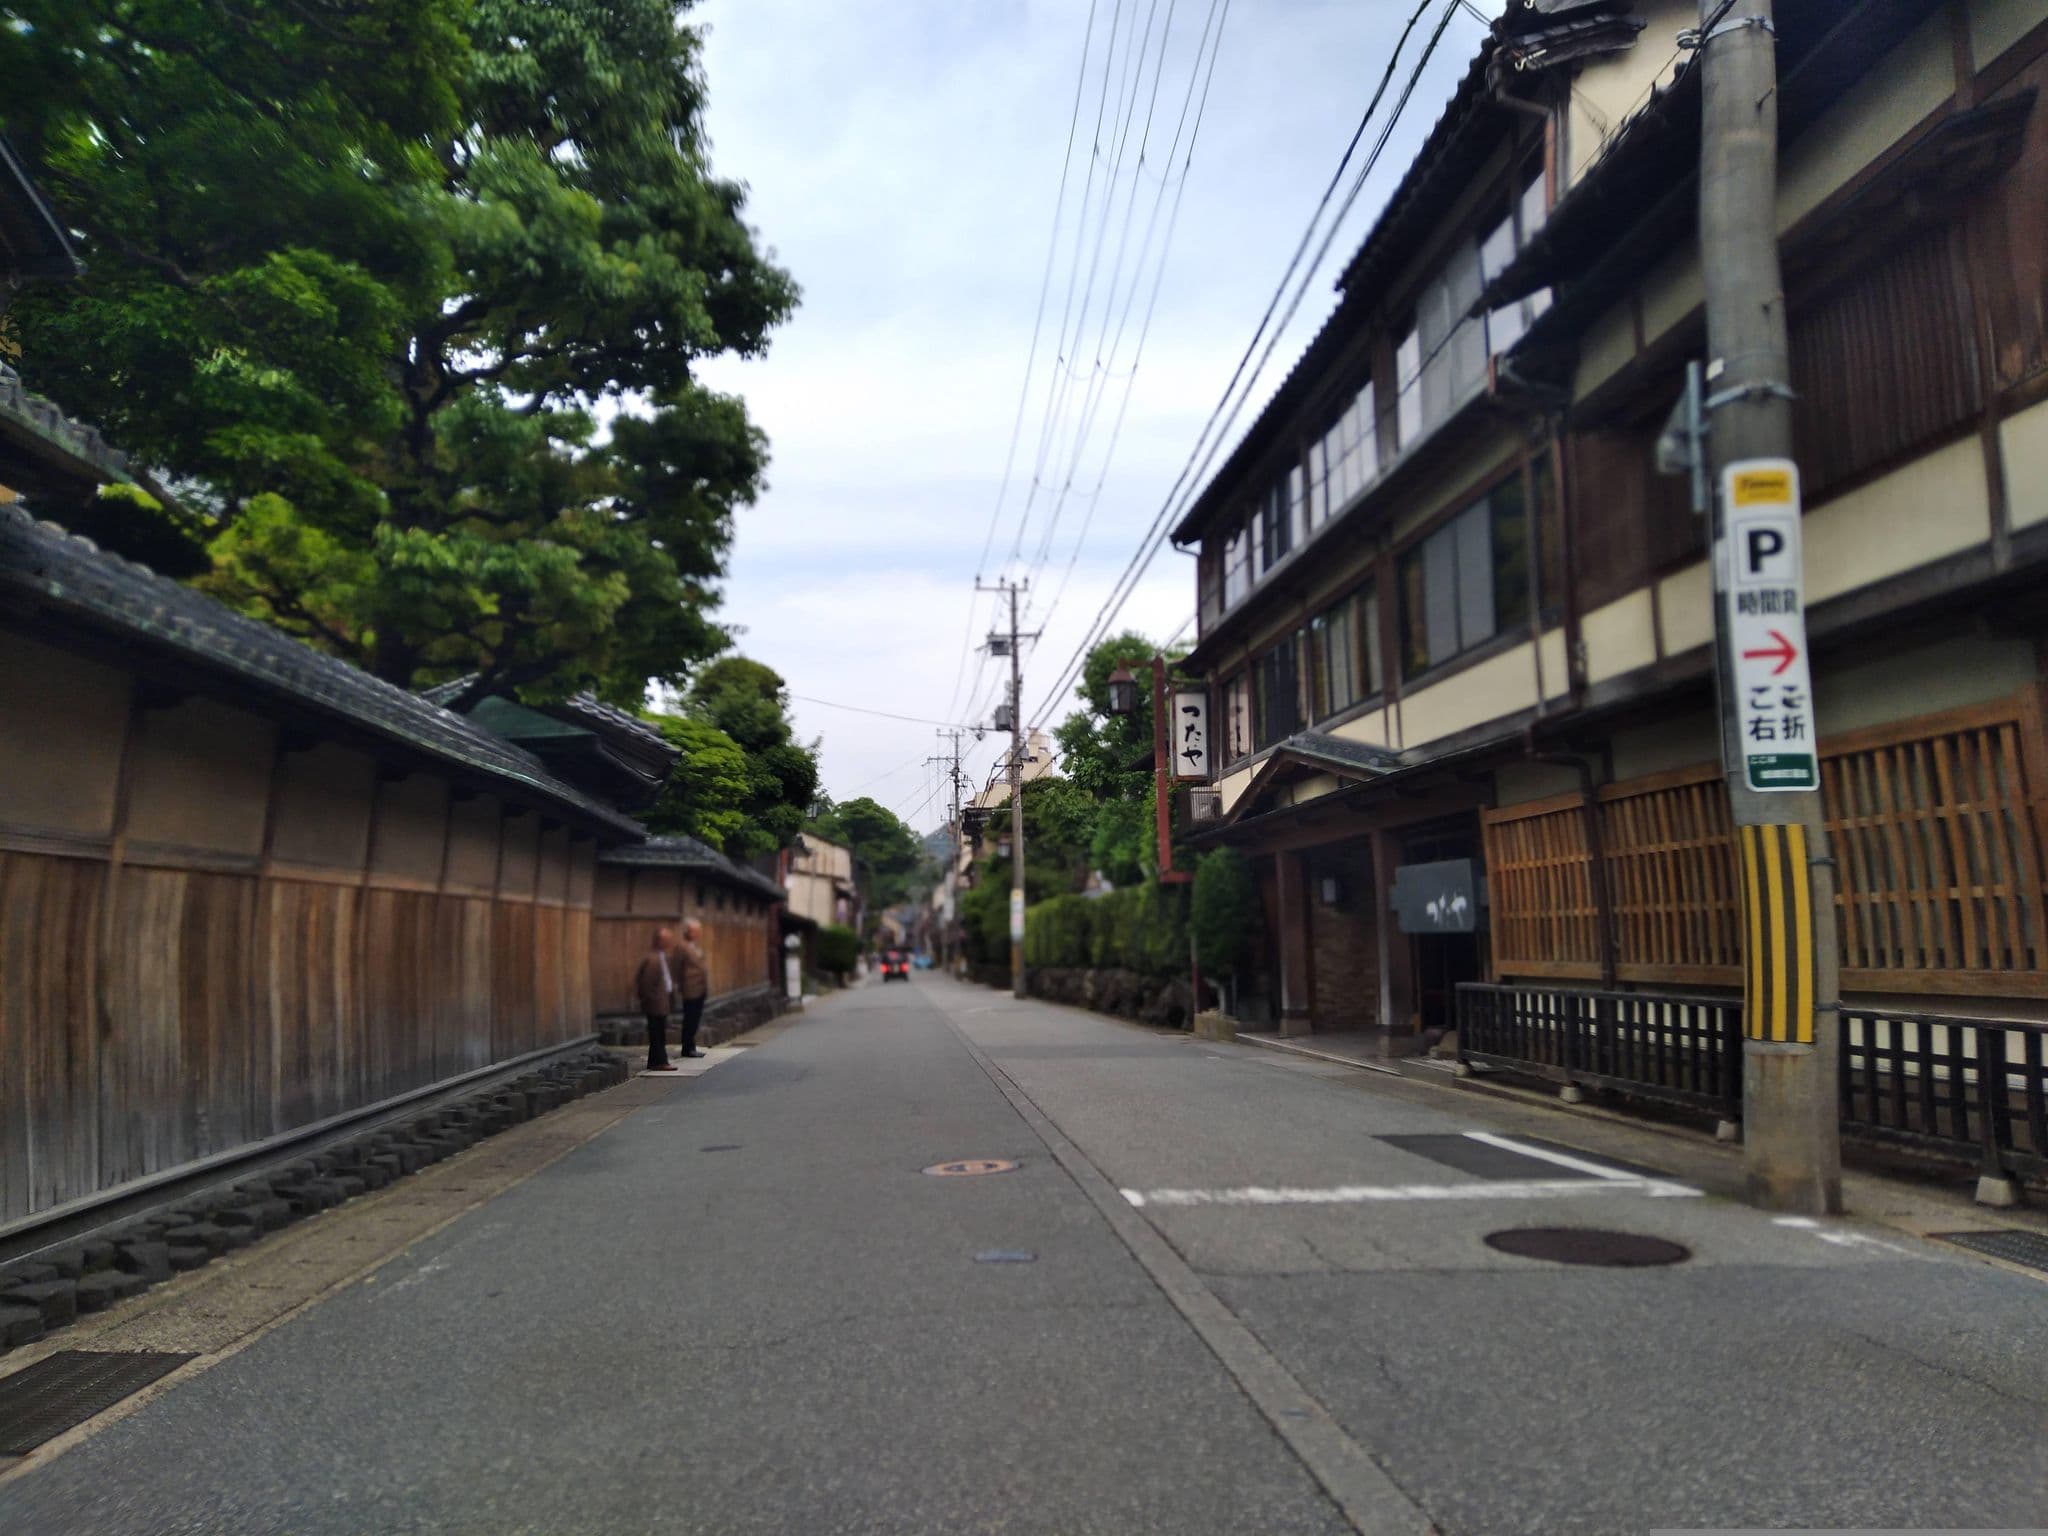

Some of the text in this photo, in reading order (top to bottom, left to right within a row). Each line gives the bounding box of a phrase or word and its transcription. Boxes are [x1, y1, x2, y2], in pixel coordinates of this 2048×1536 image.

[1747, 528, 1785, 574] P
[1181, 705, 1203, 767] つたや
[1748, 715, 1807, 742] 右折
